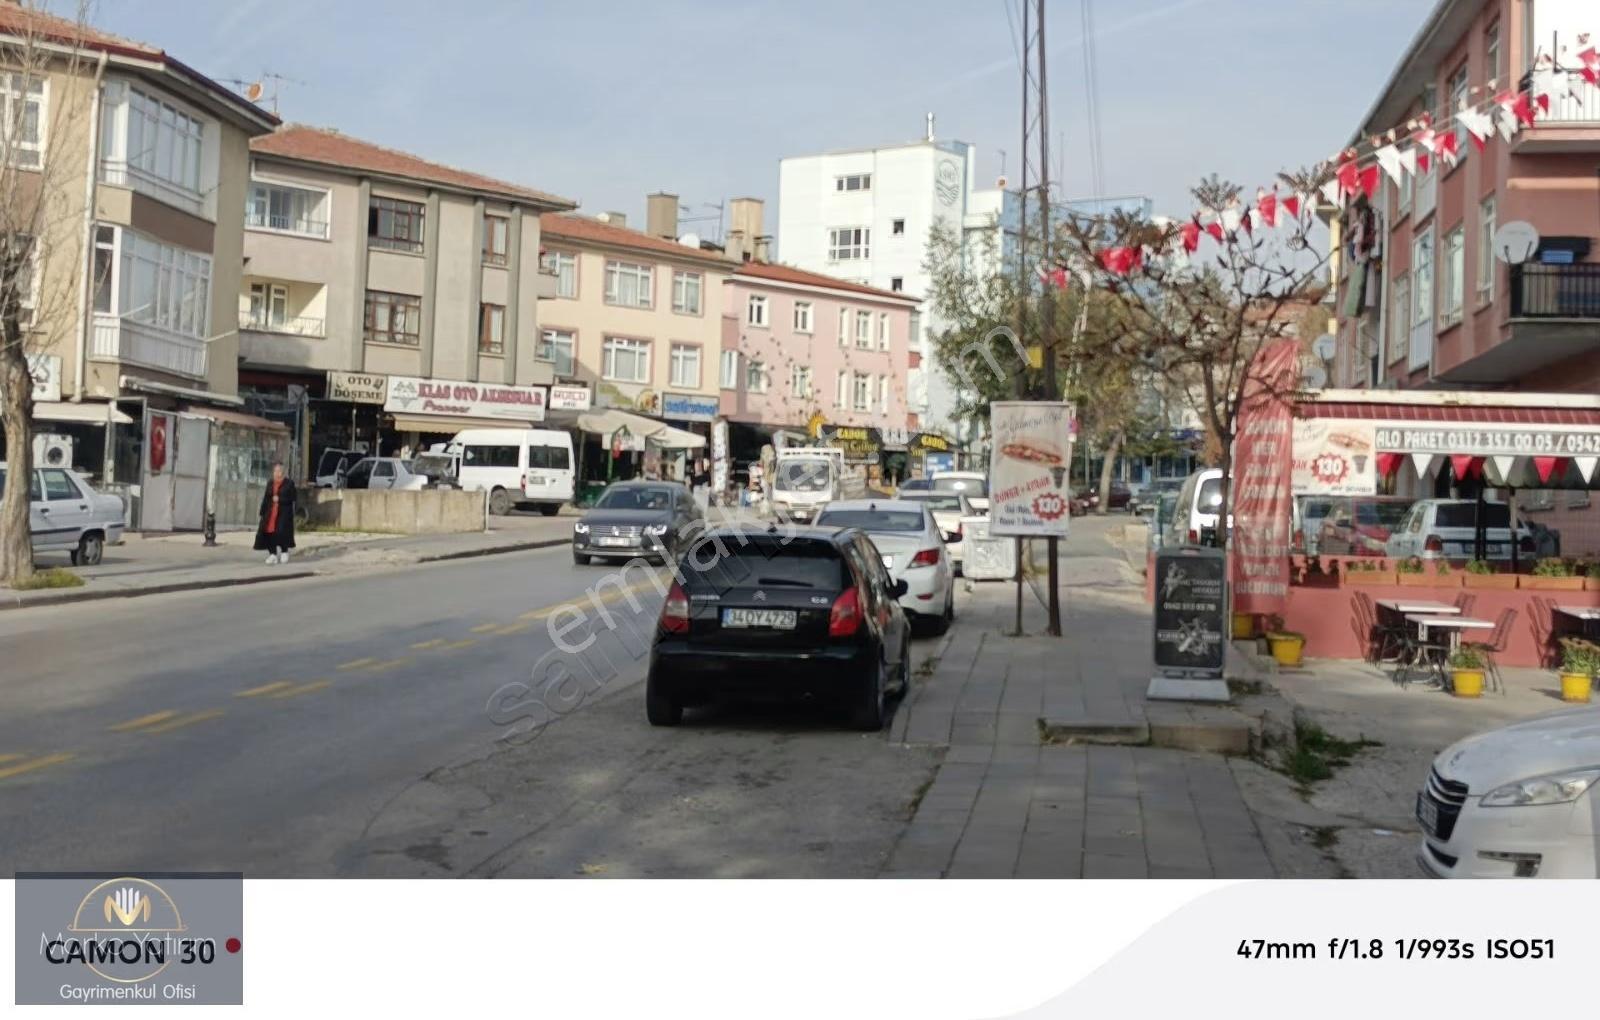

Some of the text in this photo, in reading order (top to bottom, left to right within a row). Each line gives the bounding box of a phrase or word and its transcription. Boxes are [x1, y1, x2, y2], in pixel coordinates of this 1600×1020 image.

[348, 376, 371, 385] OTO
[454, 386, 478, 402] OTO
[1376, 430, 1399, 448] ALO
[1404, 431, 1444, 449] PAKET
[1448, 431, 1480, 449] 0312
[1514, 434, 1531, 450] 00
[1317, 458, 1343, 475] 130
[1038, 498, 1059, 513] 130
